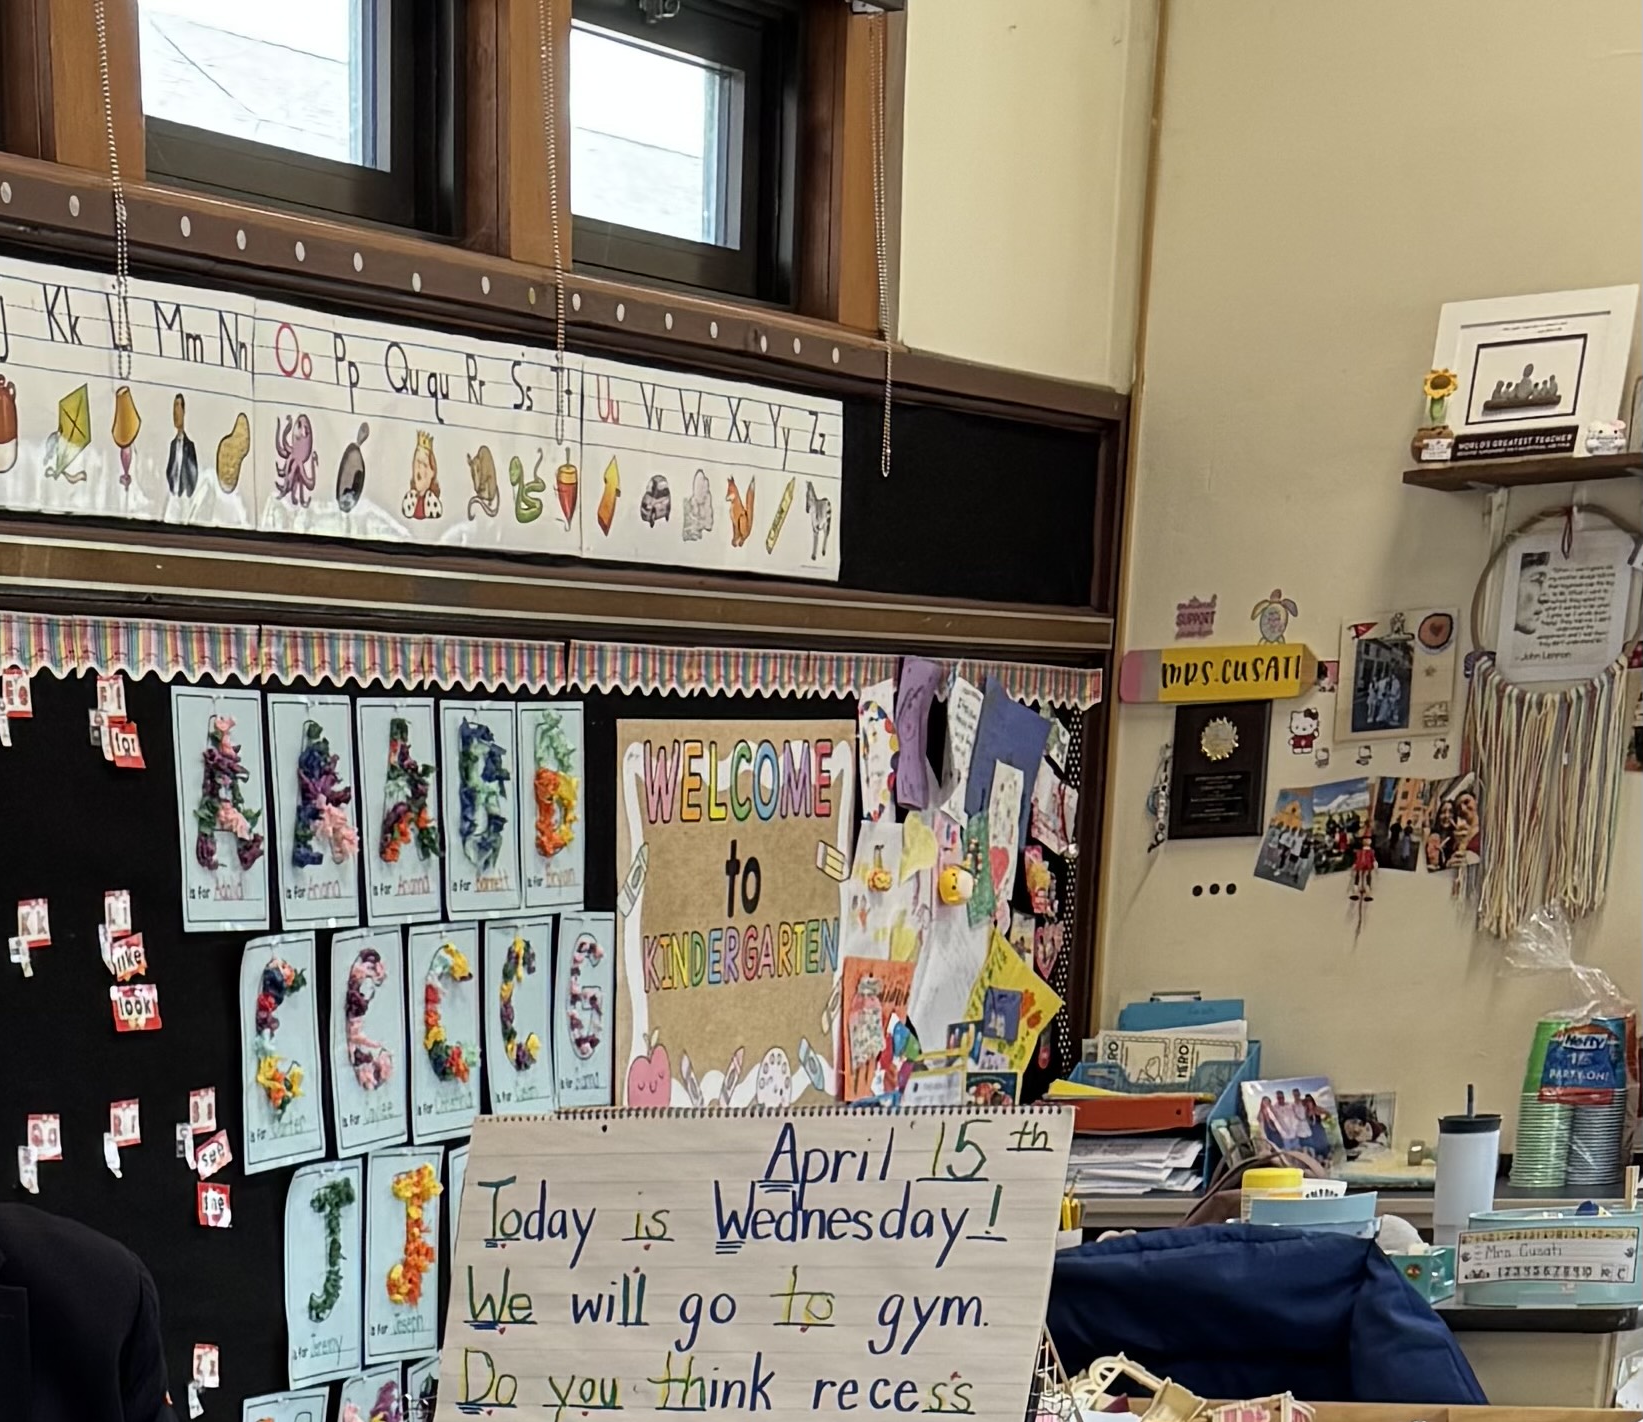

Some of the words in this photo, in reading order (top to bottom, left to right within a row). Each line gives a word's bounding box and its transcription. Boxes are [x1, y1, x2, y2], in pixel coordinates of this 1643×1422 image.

[643, 740, 832, 823] WELCOME
[726, 840, 759, 917] to
[643, 917, 838, 992] KINDERGARTEN
[764, 1123, 895, 1184] April
[931, 1119, 988, 1180] 15
[1010, 1125, 1049, 1150] th
[479, 1177, 596, 1269] Today
[633, 1192, 670, 1240] is
[466, 1266, 532, 1322] We
[572, 1269, 647, 1325] will
[679, 1292, 736, 1352] go
[771, 1266, 834, 1325] to
[458, 1348, 517, 1404] Do
[648, 1352, 775, 1411] think
[813, 1378, 975, 1411] recess
